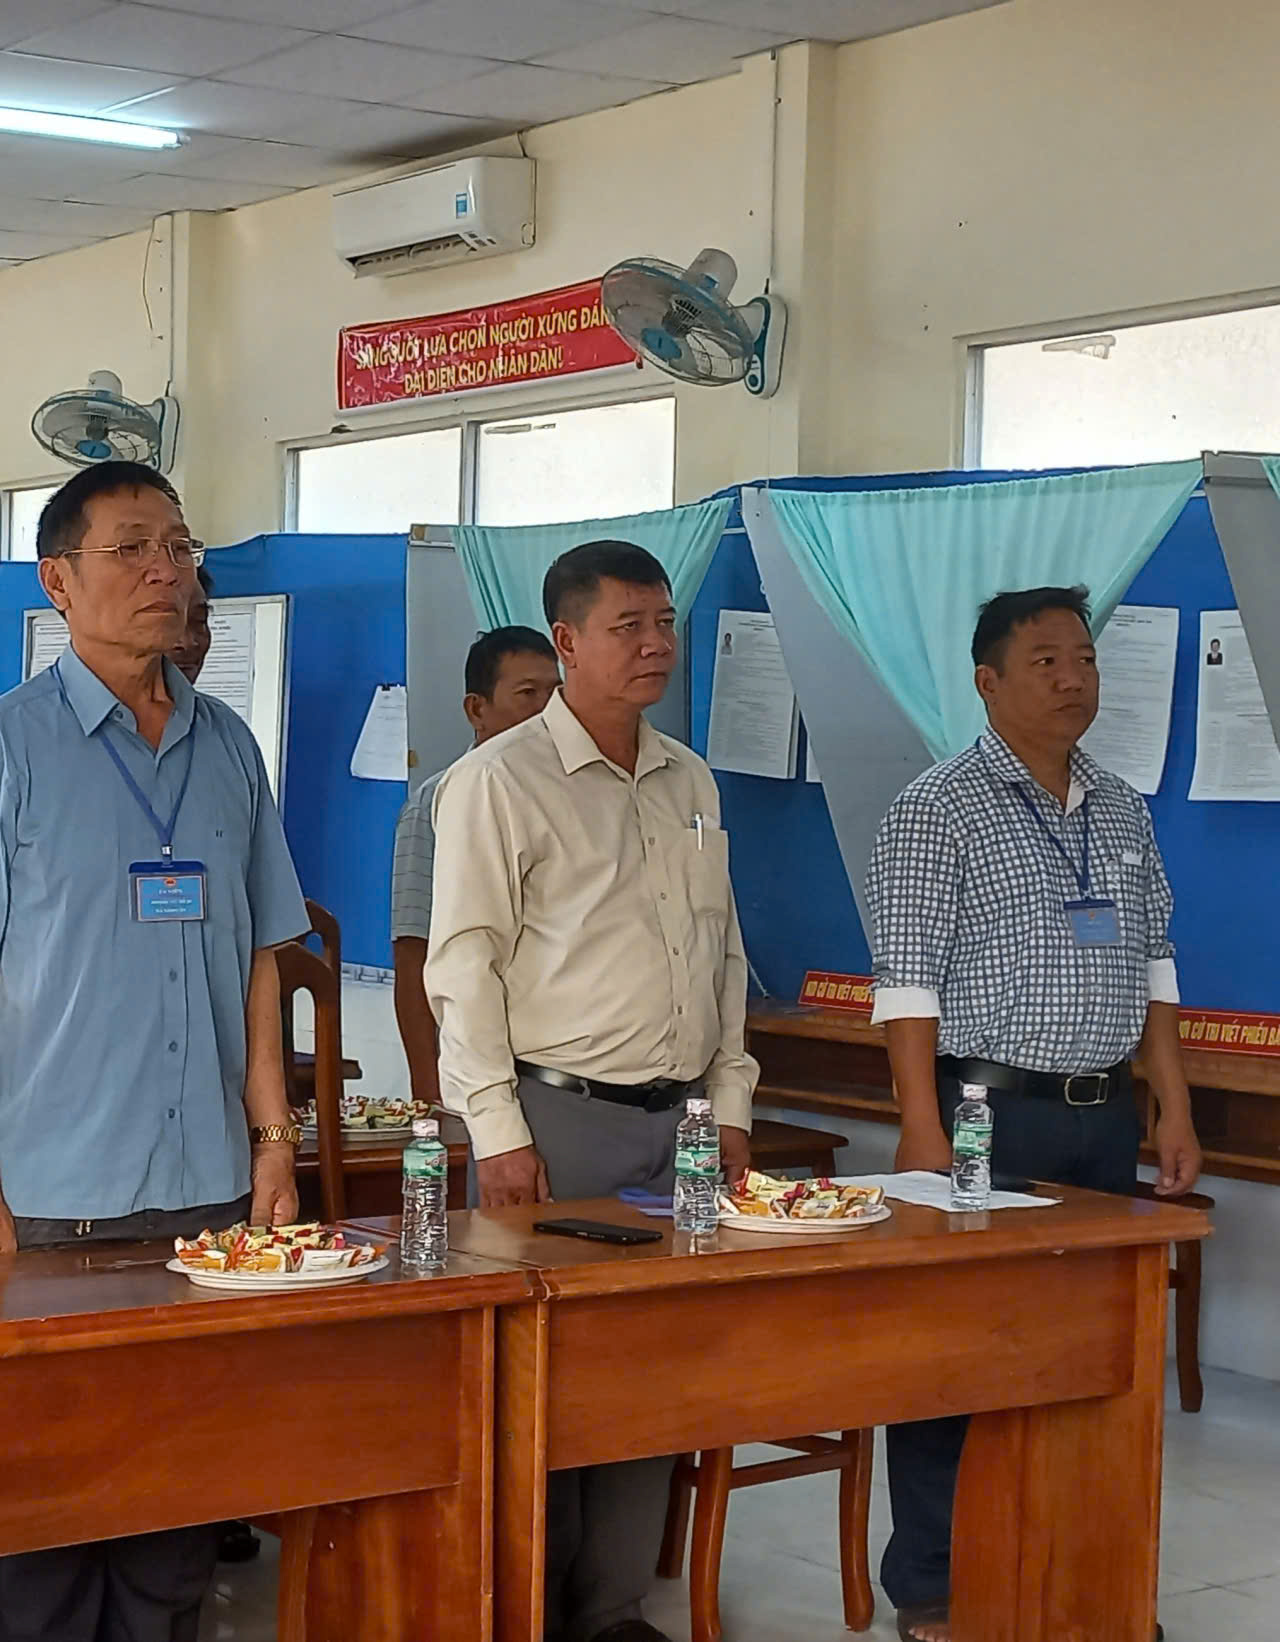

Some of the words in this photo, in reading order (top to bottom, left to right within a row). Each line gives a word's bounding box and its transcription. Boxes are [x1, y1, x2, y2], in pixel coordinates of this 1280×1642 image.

[490, 313, 534, 347] NGƯỜI
[537, 307, 578, 338] XỨNG
[581, 298, 612, 330] ĐÁN
[458, 360, 487, 385] CHO
[489, 349, 527, 381] NHÂN
[530, 344, 564, 373] DÂN!
